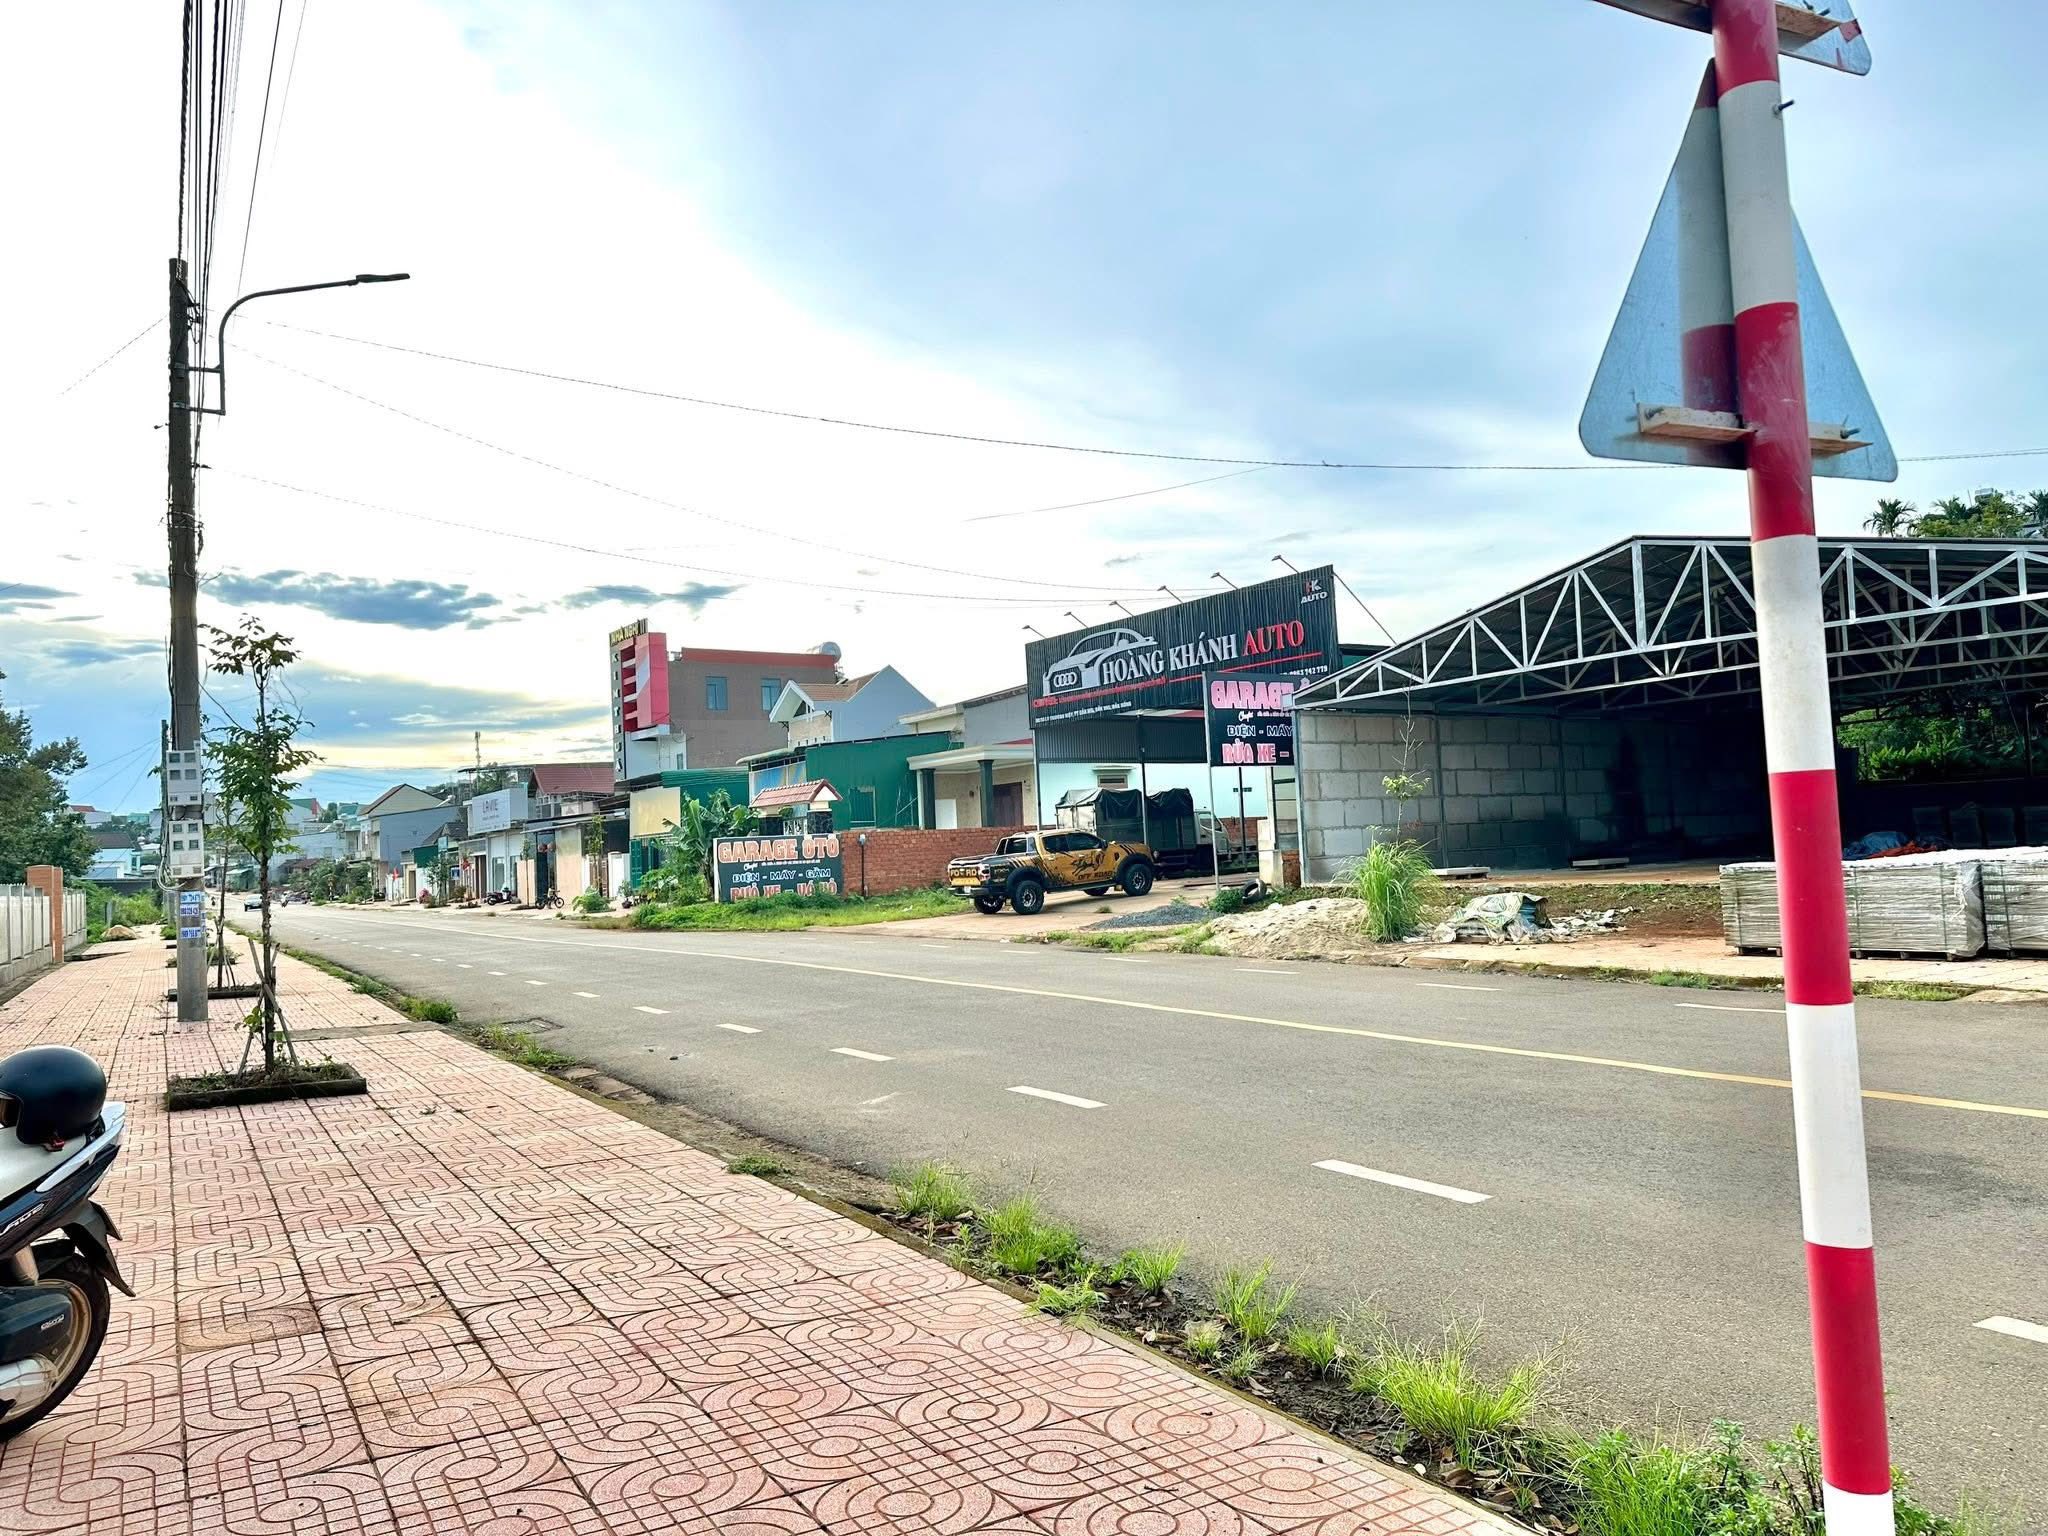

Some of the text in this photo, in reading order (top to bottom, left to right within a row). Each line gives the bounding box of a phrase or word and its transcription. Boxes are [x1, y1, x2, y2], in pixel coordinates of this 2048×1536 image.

[1301, 592, 1328, 604] AUTO
[1103, 619, 1305, 685] HOÀNG KHÁNH AUTO
[1227, 723, 1256, 738] ĐIỆN
[1257, 743, 1277, 764] XE
[718, 839, 798, 863] GARAGE
[732, 871, 760, 883] ĐIỆN
[805, 866, 831, 879] GẦM
